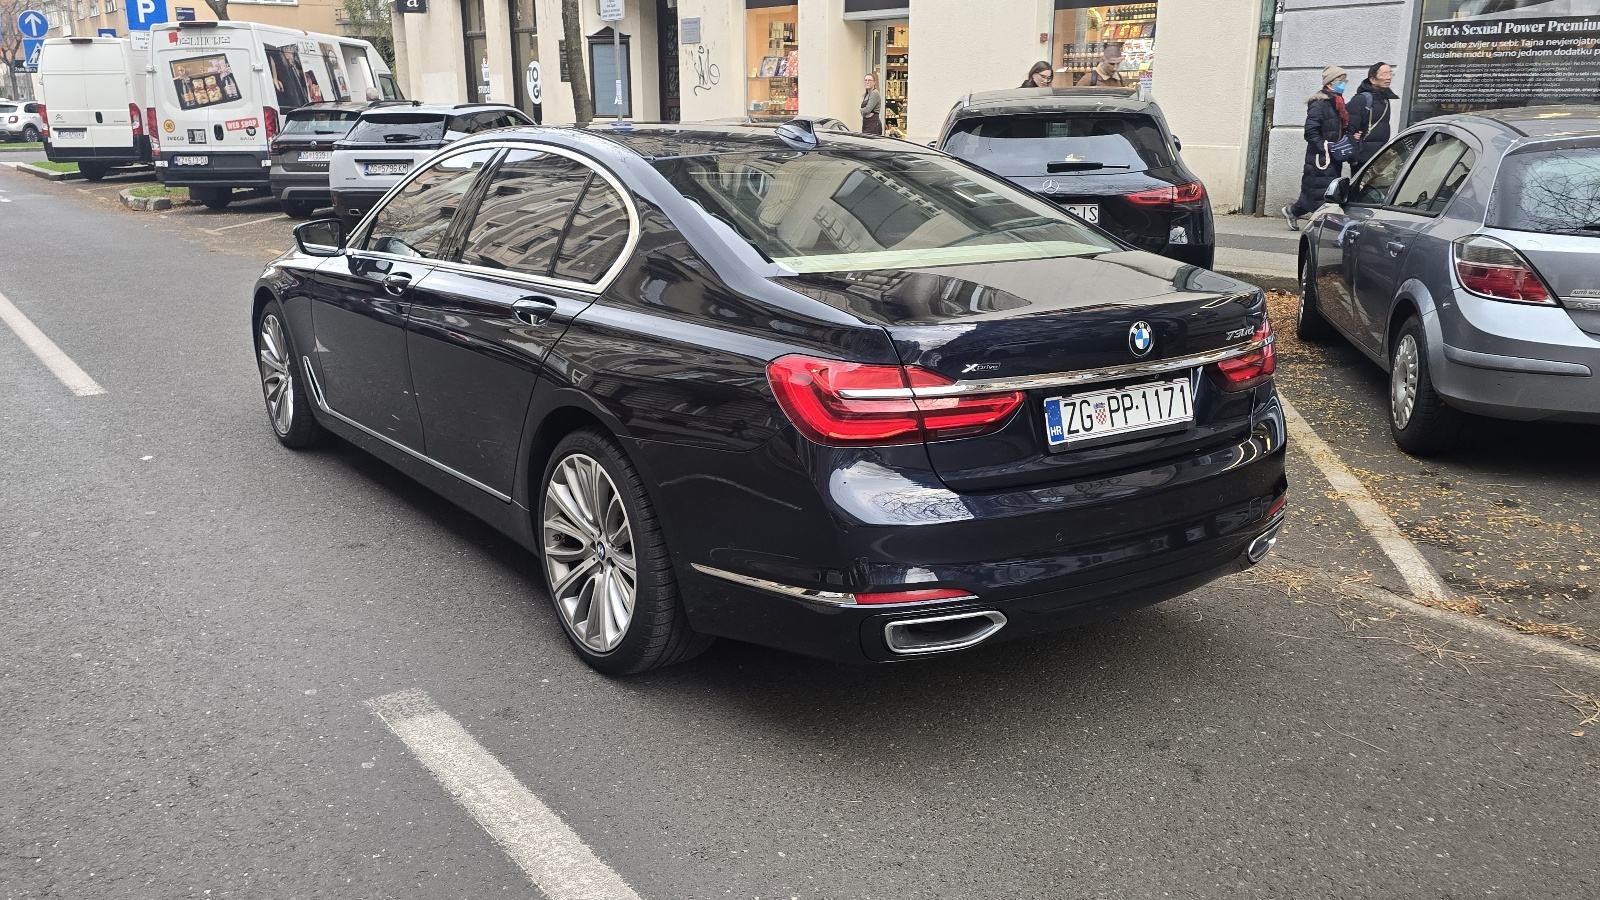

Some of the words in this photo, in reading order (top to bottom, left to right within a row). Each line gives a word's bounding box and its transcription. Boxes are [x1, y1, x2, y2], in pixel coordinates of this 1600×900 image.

[137, 0, 156, 23] P
[1425, 25, 1460, 37] Men's
[1462, 22, 1503, 36] Sexual
[1504, 22, 1546, 34] Power
[1547, 18, 1600, 32] Premiu
[1424, 41, 1467, 50] Oslobodite
[1468, 40, 1491, 49] zvijer
[1521, 38, 1544, 48] Tajna
[1422, 51, 1462, 59] seksualne
[1493, 50, 1517, 58] samo
[1517, 48, 1553, 59] jednom
[1553, 47, 1593, 56] dodatku
[527, 66, 539, 83] TO
[533, 84, 541, 99] G
[226, 121, 240, 130] WEB
[1063, 400, 1094, 436] ZG
[1050, 426, 1063, 437] HR
